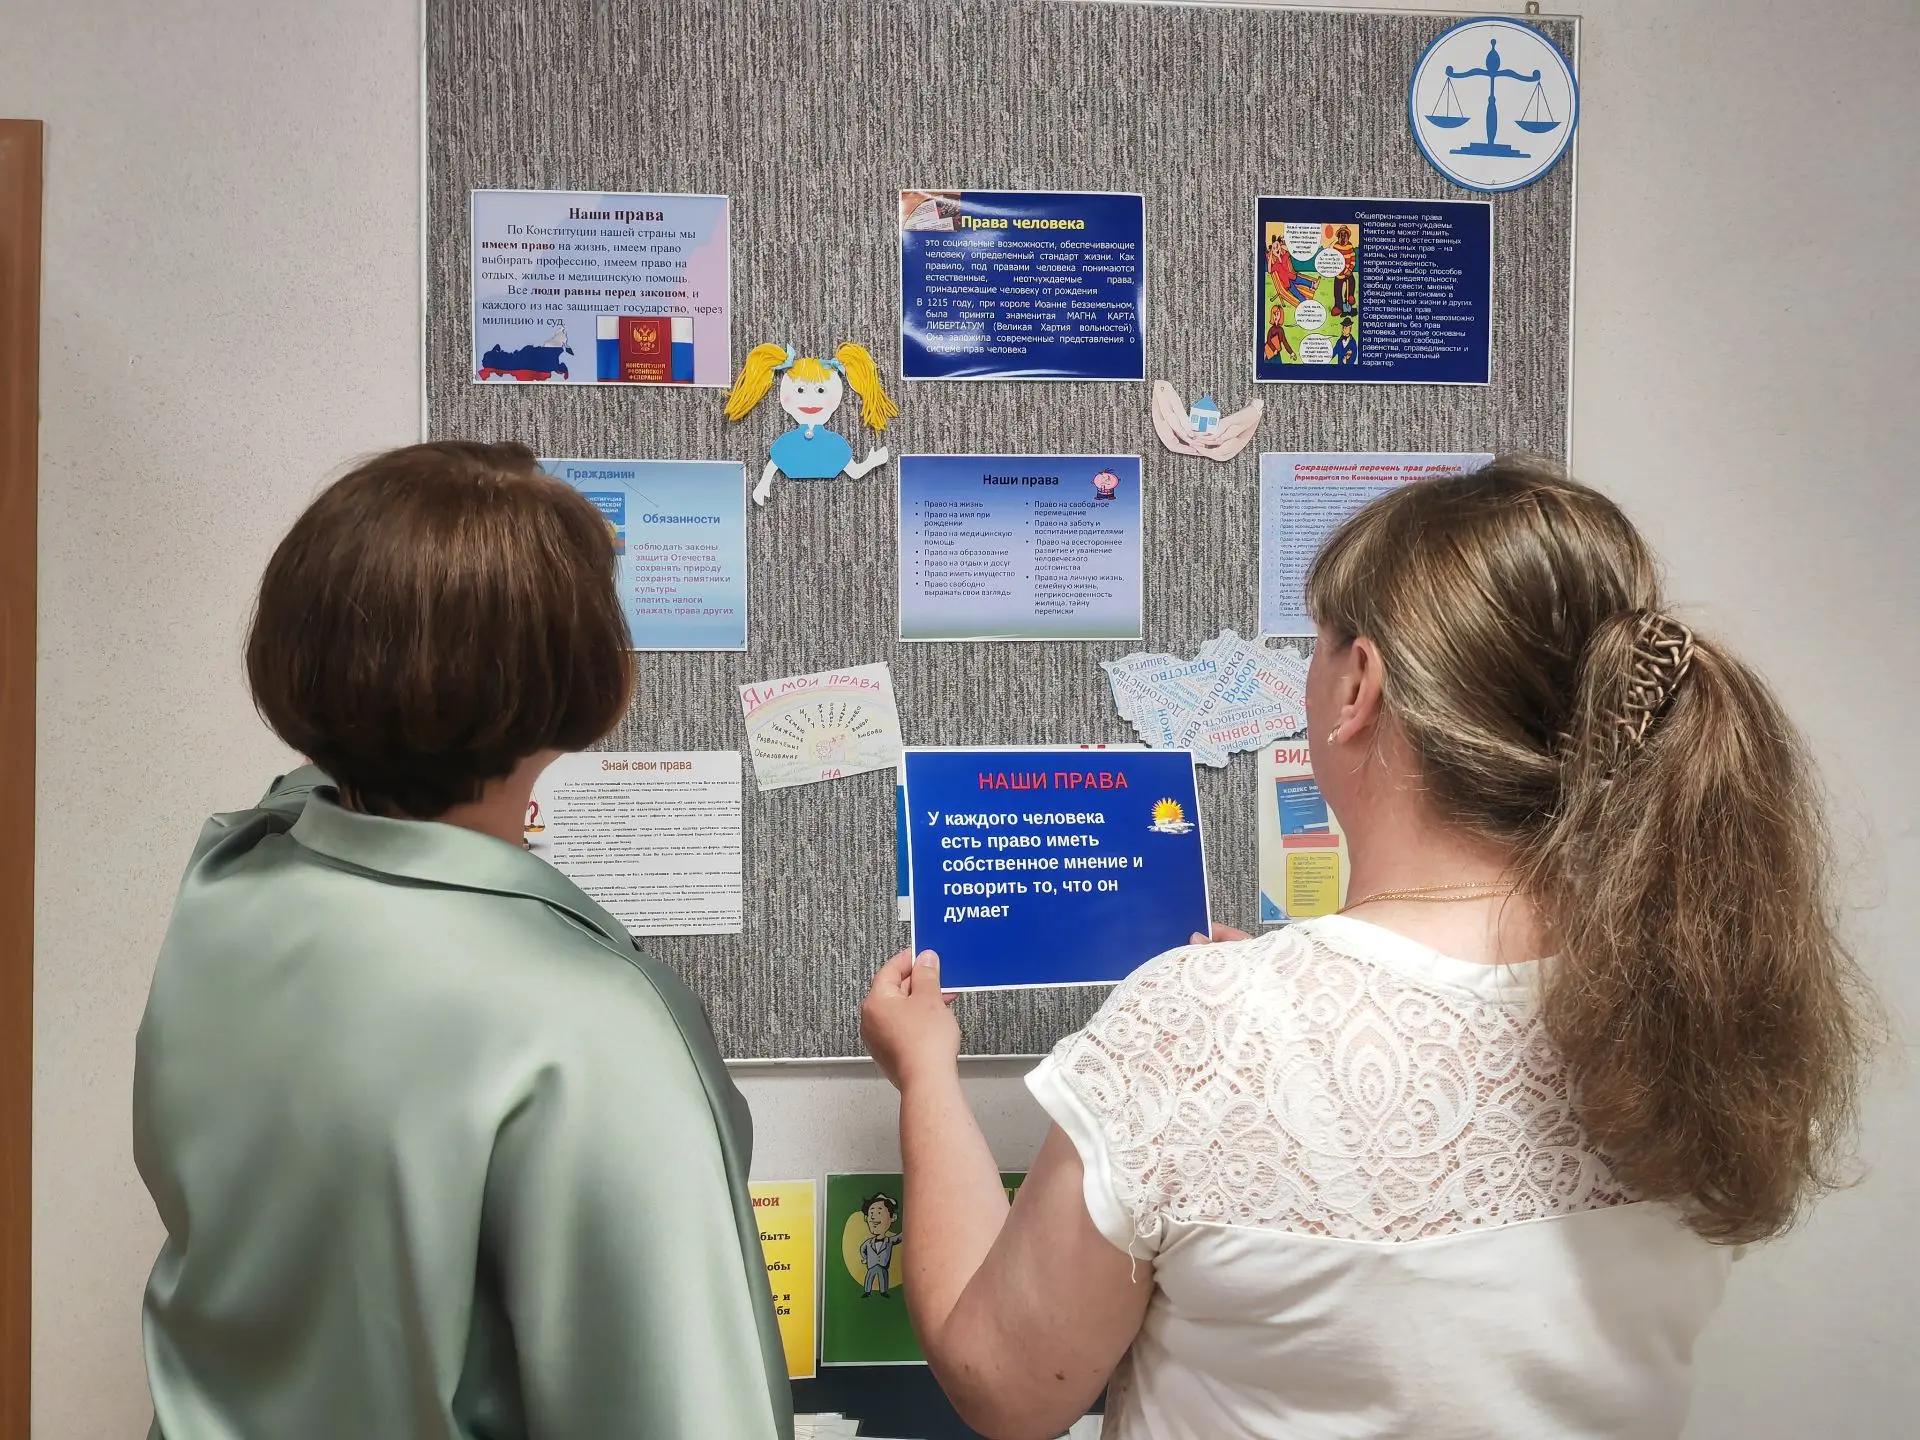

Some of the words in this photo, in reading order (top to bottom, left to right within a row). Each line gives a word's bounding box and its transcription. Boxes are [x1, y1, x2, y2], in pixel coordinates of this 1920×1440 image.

[569, 208, 610, 220] Наши
[615, 209, 664, 224] права
[961, 215, 1007, 231] Права
[1013, 218, 1084, 230] человека
[1355, 212, 1418, 220] Общепризнанные
[507, 225, 522, 235] По
[526, 226, 596, 238] Конституции
[600, 229, 635, 237] нашей
[638, 230, 675, 239] страны
[482, 241, 517, 250] имеем
[521, 242, 555, 252] право
[575, 243, 610, 252] жизнь,
[614, 244, 646, 252] имеем
[650, 245, 681, 254] право
[943, 240, 994, 249] социальные
[998, 241, 1056, 250] возможности,
[1060, 241, 1135, 250] обеспечивающие
[482, 255, 532, 266] выбирать
[537, 257, 600, 268] профессию,
[604, 259, 637, 267] имеем
[642, 259, 672, 269] право
[676, 260, 687, 268] на
[925, 251, 965, 259] человеку
[971, 252, 1034, 261] определенный
[1040, 253, 1078, 261] стандарт
[1084, 253, 1113, 261] жизни.
[1119, 253, 1134, 261] Как
[925, 262, 965, 272] правило,
[971, 263, 987, 272] под
[993, 264, 1030, 272] правами
[1036, 264, 1076, 272] человека
[481, 271, 517, 281] отдых,
[522, 272, 555, 281] жилье
[568, 273, 641, 283] медицинскую
[508, 285, 527, 294] Все
[531, 287, 561, 296] люди
[564, 287, 600, 298] равны
[605, 289, 636, 299] перед
[640, 290, 688, 299] законом,
[692, 290, 699, 298] и
[482, 302, 526, 312] каждого
[545, 303, 562, 311] нас
[567, 304, 619, 313] защищает
[624, 305, 690, 314] государство,
[695, 306, 723, 315] через
[926, 310, 947, 318] была
[960, 311, 995, 319] принята
[1006, 312, 1056, 320] знаменитая
[1067, 312, 1096, 320] МАГНА
[1107, 312, 1135, 320] КАРТА
[482, 317, 534, 326] милицию
[547, 319, 565, 327] суд.
[567, 468, 635, 479] Гражданин
[1295, 464, 1357, 472] Сокращенный
[983, 475, 1018, 485] Наши
[1022, 475, 1059, 487] права
[643, 514, 720, 524] Обязанности
[634, 543, 683, 551] соблюдать
[925, 549, 947, 557] Право
[636, 565, 681, 573] сохранять
[684, 565, 721, 573] природу
[636, 575, 681, 583] сохранять
[635, 586, 677, 594] культуры
[636, 607, 672, 615] уважать
[675, 607, 700, 615] права
[703, 607, 733, 615] других
[1128, 656, 1170, 671] Защита
[1151, 659, 1216, 683] Братство
[1222, 659, 1257, 704] Выбор
[1256, 668, 1297, 699] люди
[743, 687, 761, 710] Я
[829, 675, 880, 690] ПРАВА
[1237, 679, 1260, 705] Мир
[1177, 721, 1201, 749] ава
[1197, 651, 1244, 717] человека
[1203, 704, 1282, 728] Безопасность
[1265, 716, 1296, 730] Все
[1157, 709, 1174, 748] Закон
[1209, 720, 1260, 744] равны
[1275, 749, 1312, 766] ВИД
[602, 760, 628, 771] Знай
[632, 761, 657, 770] свои
[660, 760, 692, 772] права
[822, 768, 841, 780] НА
[978, 772, 1047, 790] НАШИ
[1055, 772, 1128, 789] ПРАВА
[927, 812, 940, 826] У
[945, 812, 1017, 828] каждого
[1023, 811, 1104, 825] человека
[941, 836, 981, 849] есть
[988, 835, 1041, 850] право
[1046, 834, 1099, 847] иметь
[942, 856, 1058, 871] собственное
[1064, 856, 1128, 869] мнение
[1134, 856, 1143, 868] и
[944, 881, 1027, 896] говорить
[1033, 881, 1057, 894] то,
[1063, 880, 1091, 893] что
[1098, 879, 1118, 891] он
[944, 904, 1009, 922] думает
